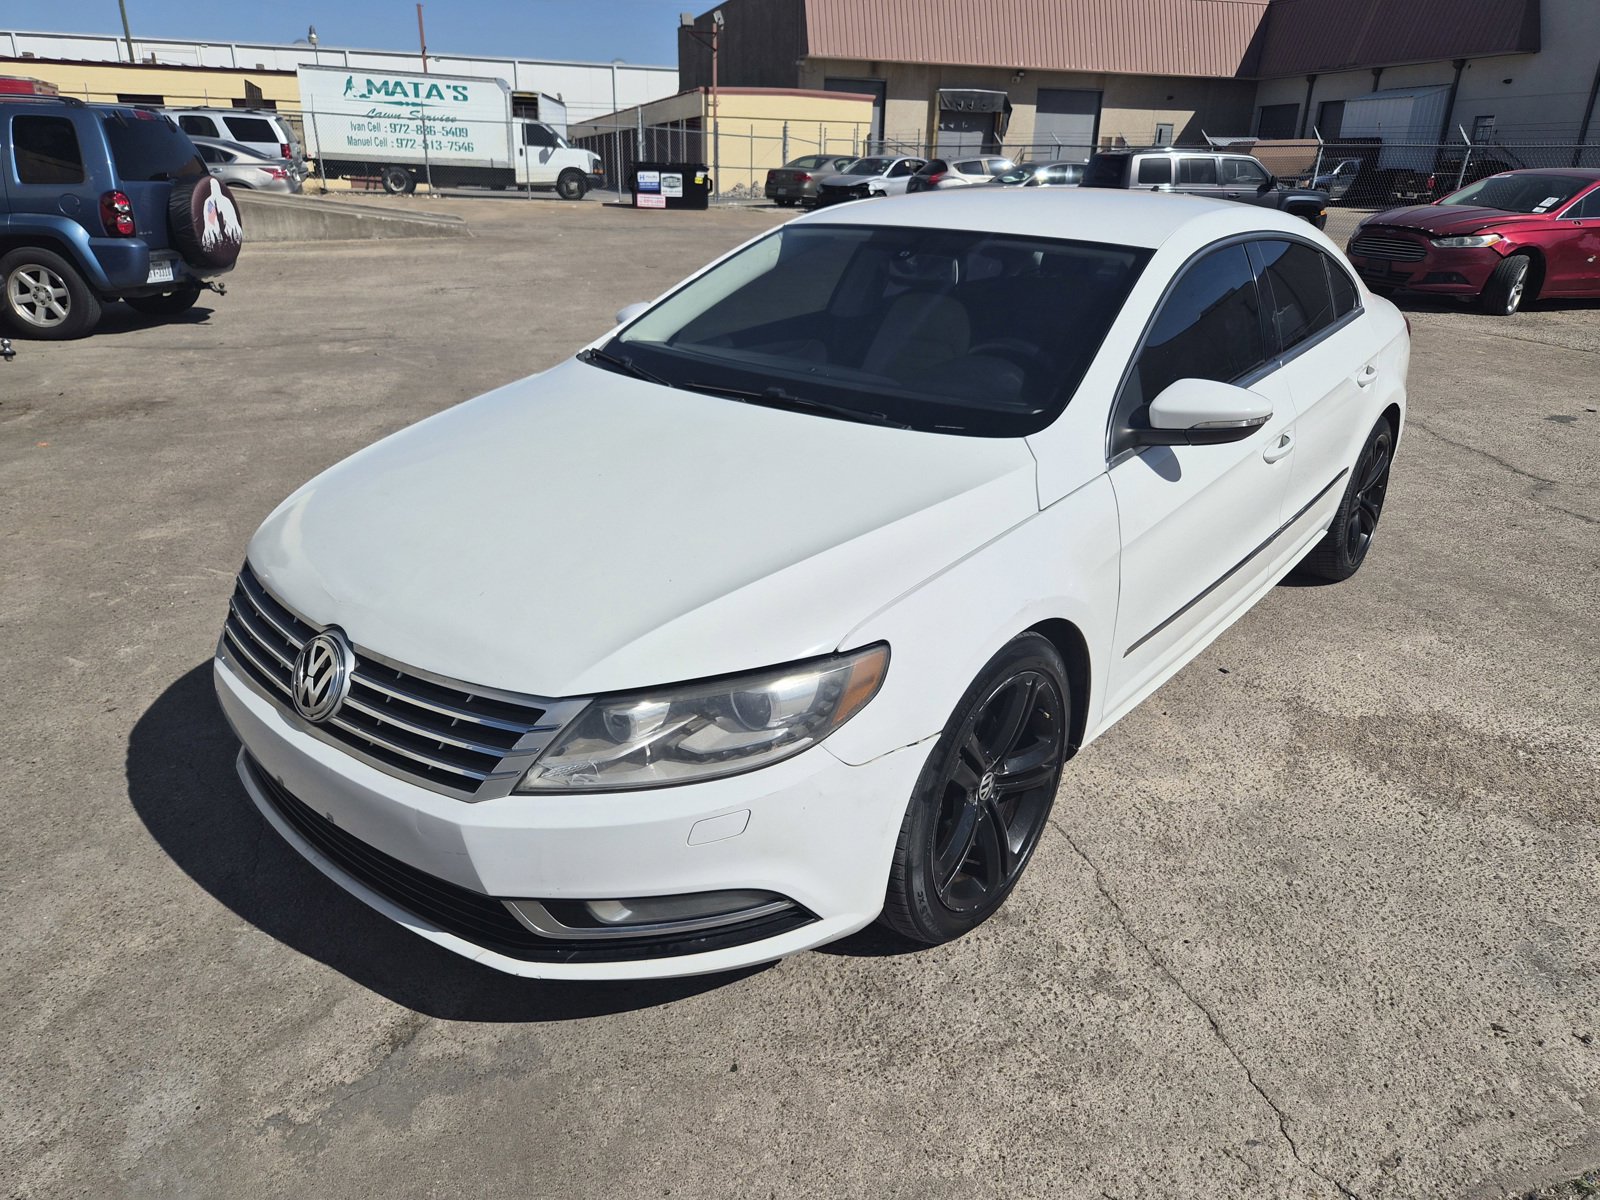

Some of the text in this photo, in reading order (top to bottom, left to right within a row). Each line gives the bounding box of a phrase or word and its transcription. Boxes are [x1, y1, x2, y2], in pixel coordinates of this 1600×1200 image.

[366, 78, 469, 102] MATA'S
[365, 108, 458, 123] Lawn Service
[350, 121, 366, 132] Ivan
[367, 122, 382, 134] Cell
[347, 135, 372, 147] Manuel
[374, 137, 388, 148] Cell
